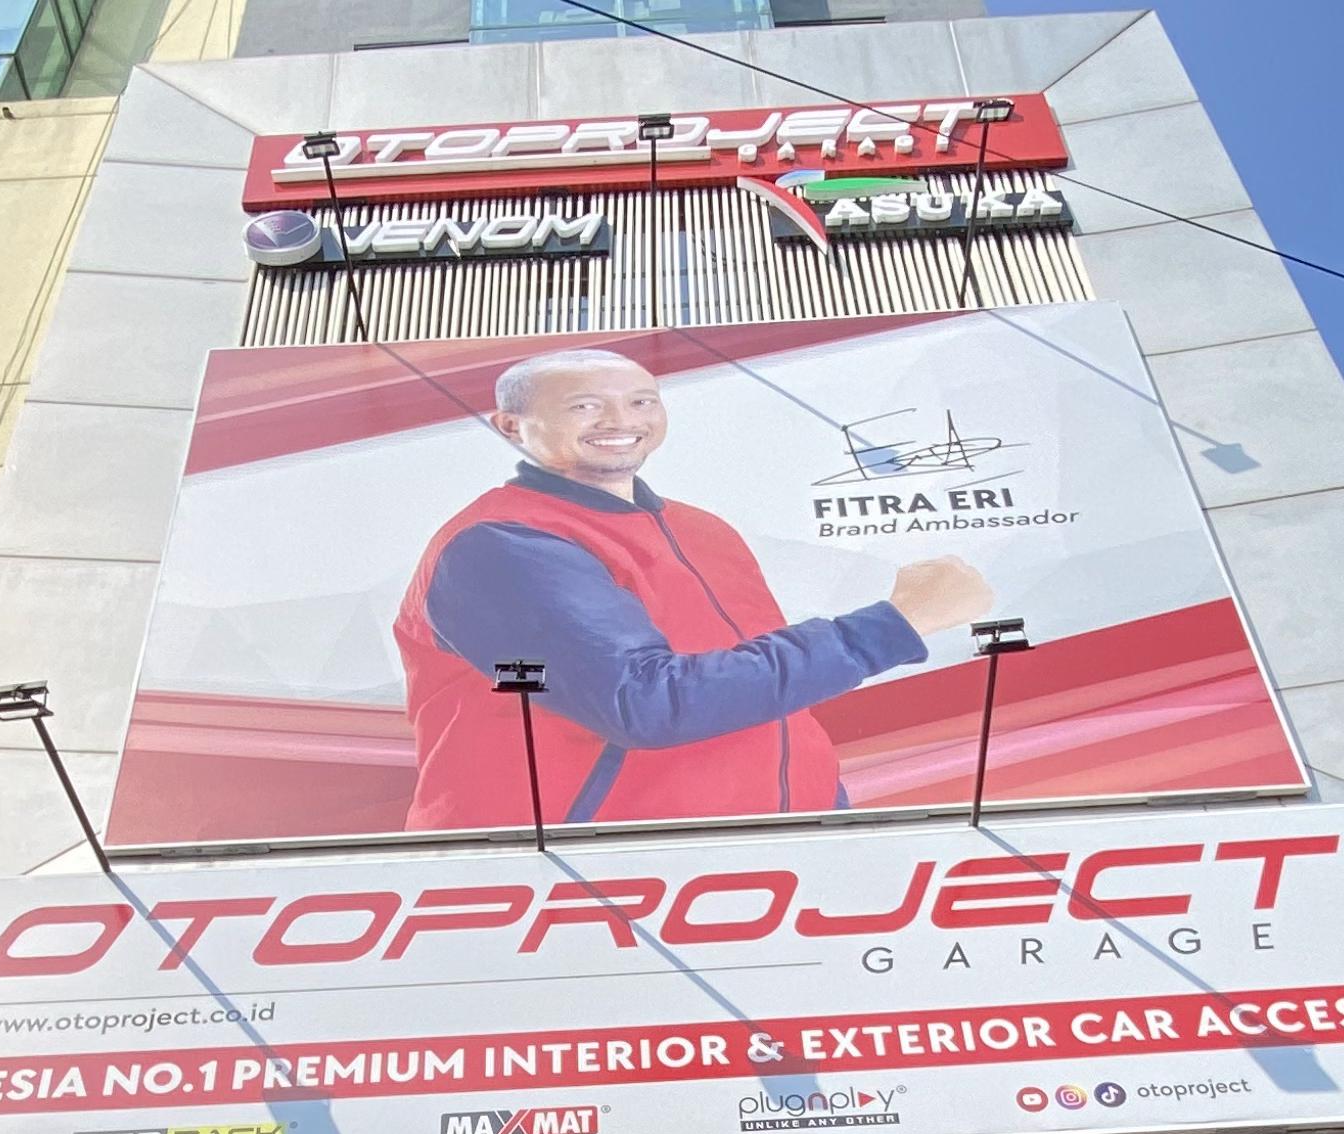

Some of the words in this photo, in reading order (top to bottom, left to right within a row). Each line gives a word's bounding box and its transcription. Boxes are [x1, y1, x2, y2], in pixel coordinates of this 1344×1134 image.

[283, 97, 1012, 168] OTOPROJECT
[825, 188, 1062, 227] ASUKA
[332, 212, 604, 256] VENOM
[813, 493, 938, 518] FITRA
[948, 488, 1015, 511] ERI
[819, 518, 897, 537] Brand
[906, 509, 1079, 533] Ambassador
[861, 923, 1275, 975] GARAGE
[103, 1060, 217, 1097] NO.1
[232, 1048, 465, 1090] PREMIUM
[483, 1031, 731, 1079] INTERIOR
[747, 1032, 785, 1063] &
[803, 1015, 1057, 1061] EXTERIOR
[1070, 1008, 1180, 1046] CAR
[1136, 1078, 1252, 1102] otoproject
[745, 1119, 800, 1131] UNLIKE
[808, 1117, 838, 1127] ANY
[846, 1114, 896, 1125] OTHER
